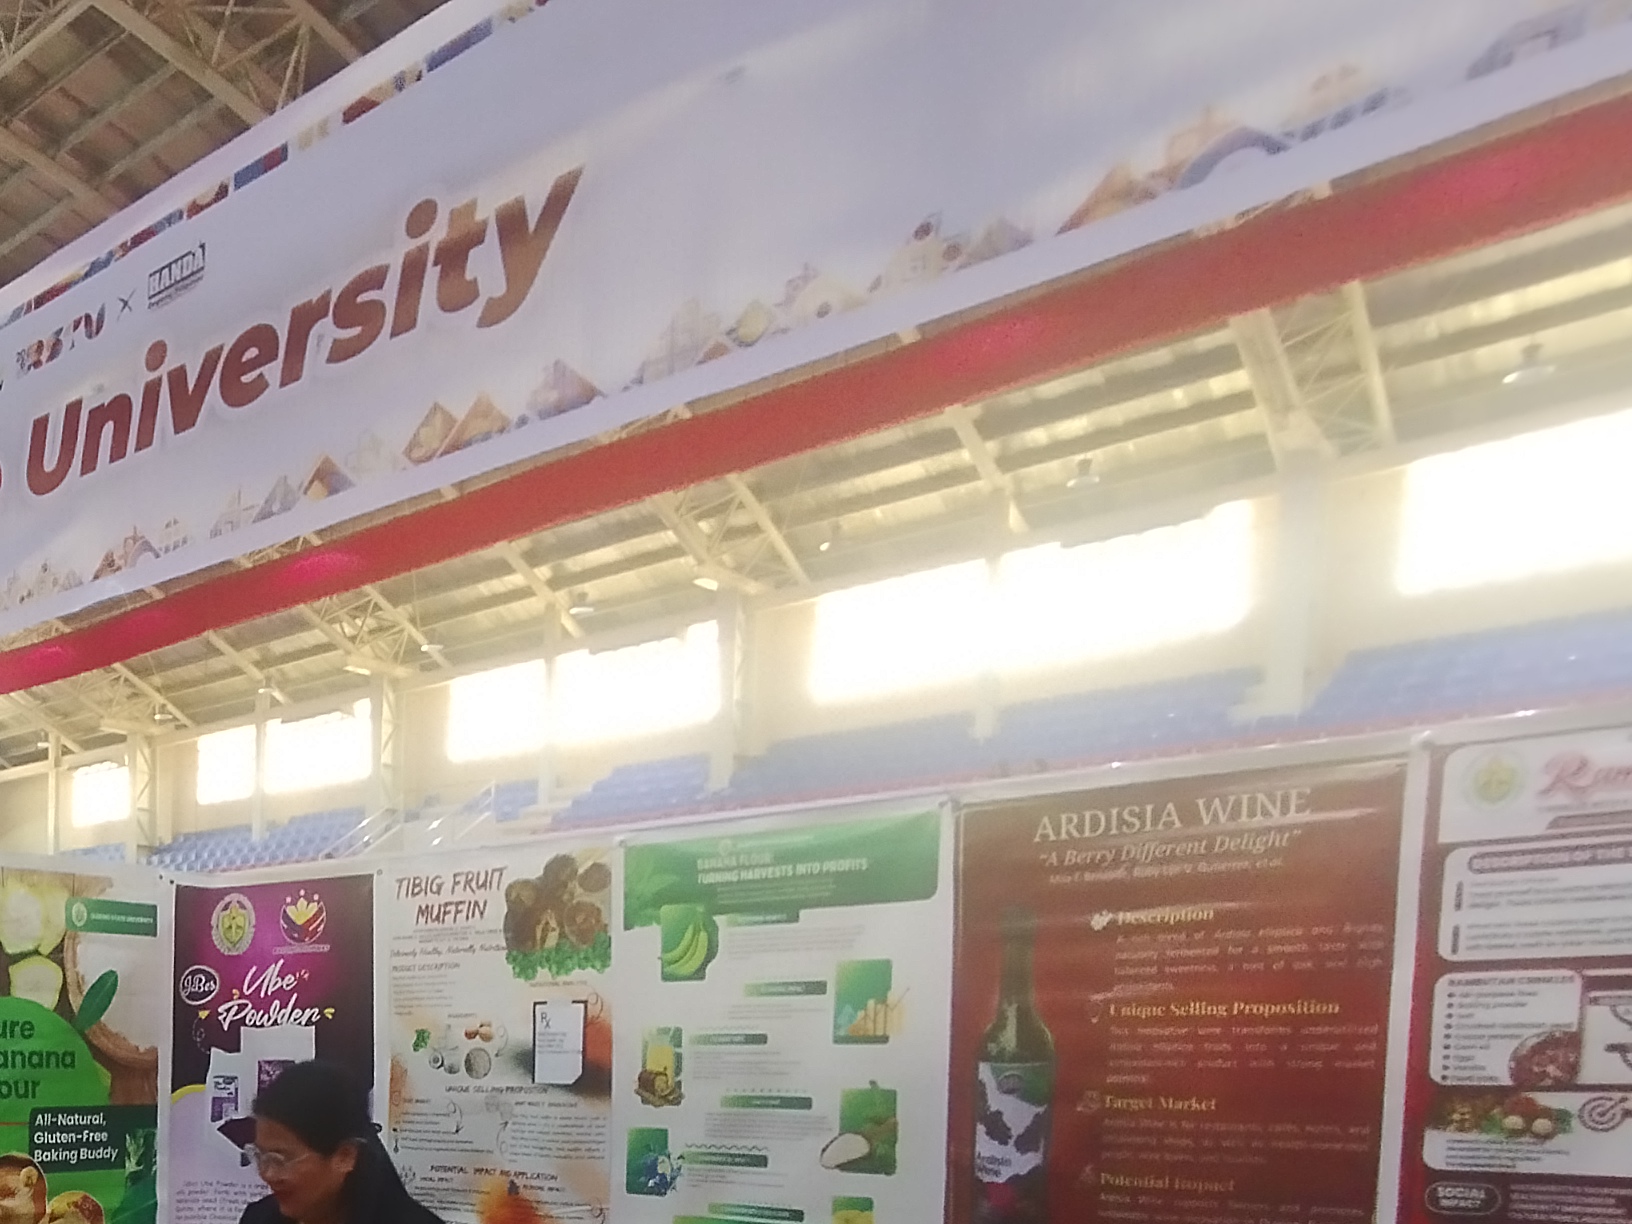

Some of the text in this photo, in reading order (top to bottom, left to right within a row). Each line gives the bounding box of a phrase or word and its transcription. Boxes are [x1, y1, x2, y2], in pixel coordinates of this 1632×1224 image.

[25, 165, 584, 498] University
[1034, 787, 1312, 843] ARDISIA WINE
[1064, 848, 1115, 866] Berry
[1120, 839, 1208, 863] Different
[395, 866, 508, 900] TIBIG FRUIT
[698, 858, 868, 884] TURNING HARVESTS INTO PROFITS
[415, 900, 488, 926] MUFFIN
[1119, 908, 1214, 927] Description
[242, 959, 297, 998] Ube
[218, 993, 321, 1031] Powder
[1170, 1001, 1228, 1017] Selling
[1232, 999, 1340, 1018] Proposition
[1105, 1095, 1216, 1112] Target Market
[35, 1113, 107, 1127] All-Natural,
[34, 1130, 108, 1145] Gluten-Free
[34, 1147, 118, 1164] Baking Buddy
[1100, 1173, 1169, 1189] Potential
